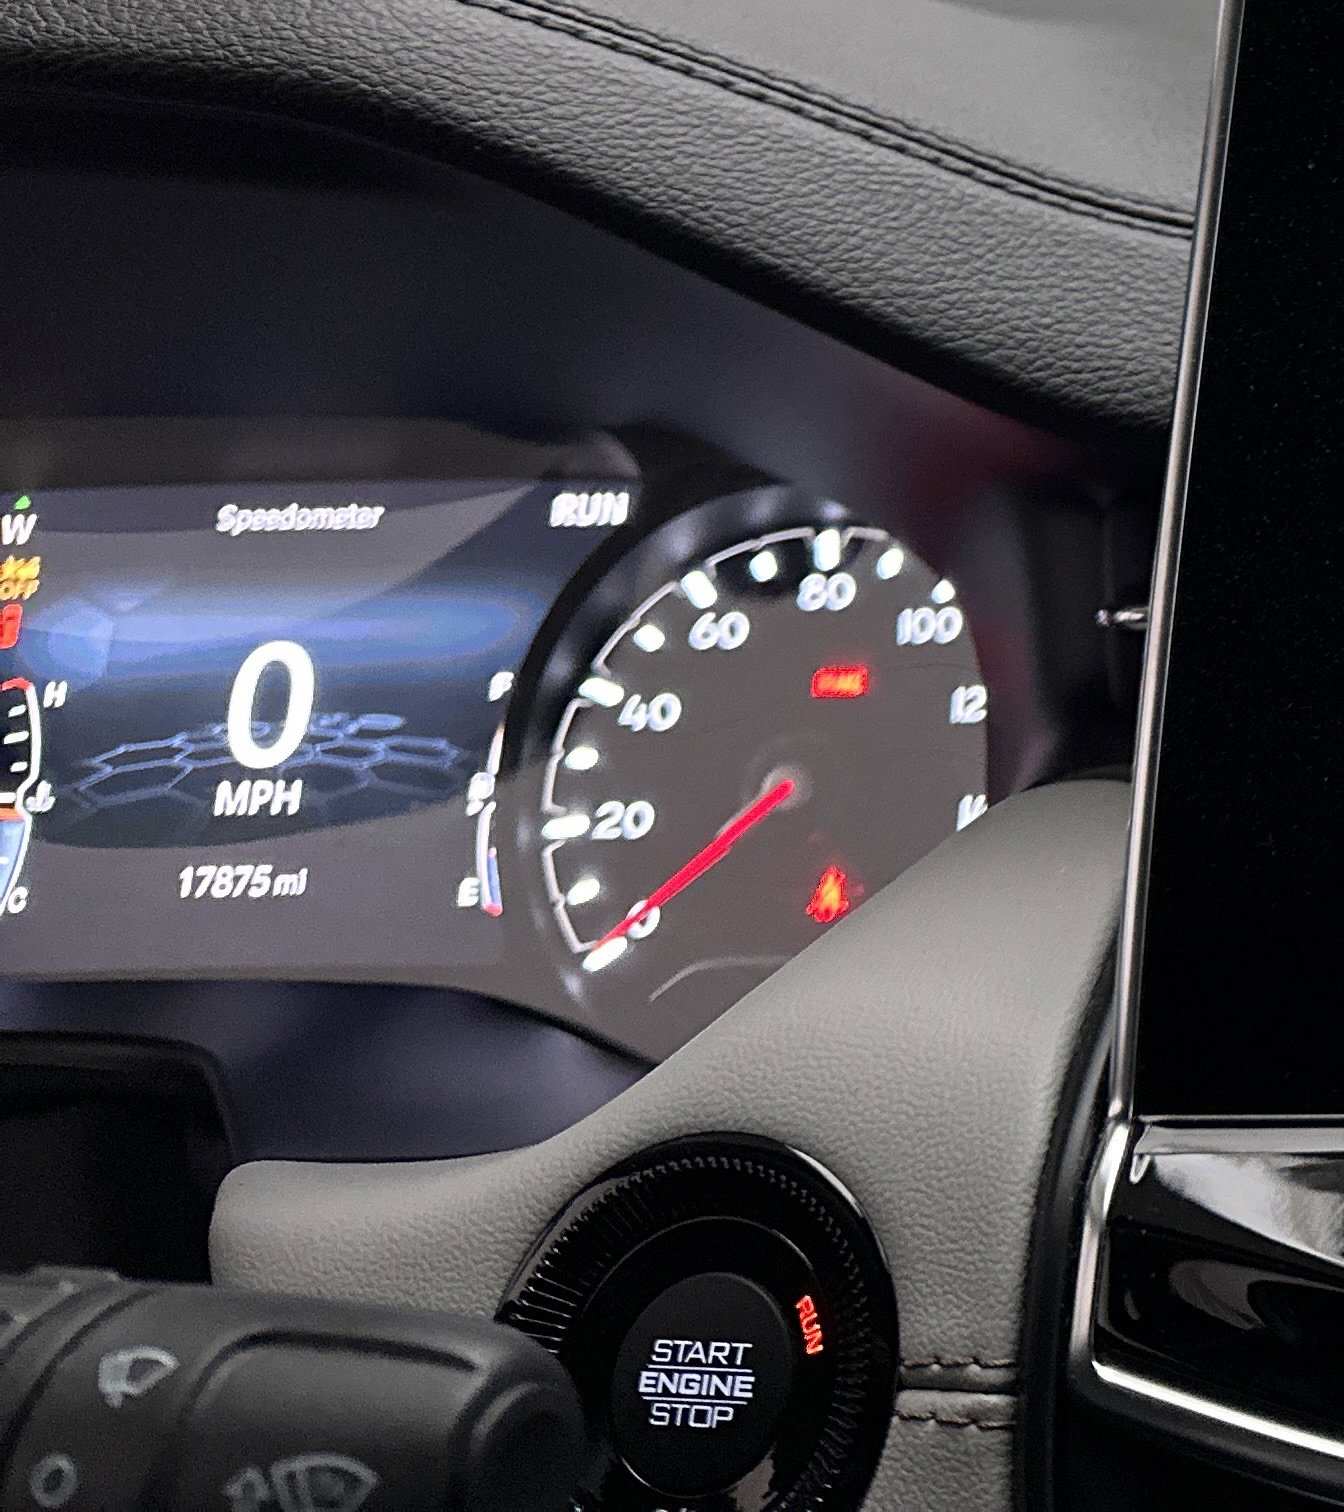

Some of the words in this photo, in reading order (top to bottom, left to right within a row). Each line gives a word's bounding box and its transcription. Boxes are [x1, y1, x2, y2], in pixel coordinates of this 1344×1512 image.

[215, 503, 386, 537] Speedometer
[550, 491, 629, 527] RUN
[797, 572, 857, 612] 80
[688, 611, 750, 651] 60
[897, 606, 963, 646] 100
[43, 680, 68, 708] H
[227, 640, 315, 770] 0
[618, 692, 682, 732] 40
[213, 779, 303, 817] MPH
[590, 800, 655, 840] 20
[179, 864, 272, 899] 17875
[273, 867, 309, 897] mi
[795, 1294, 824, 1355] RUN
[651, 1339, 753, 1365] START
[638, 1370, 755, 1399] ENGINE
[649, 1402, 734, 1429] STOP
